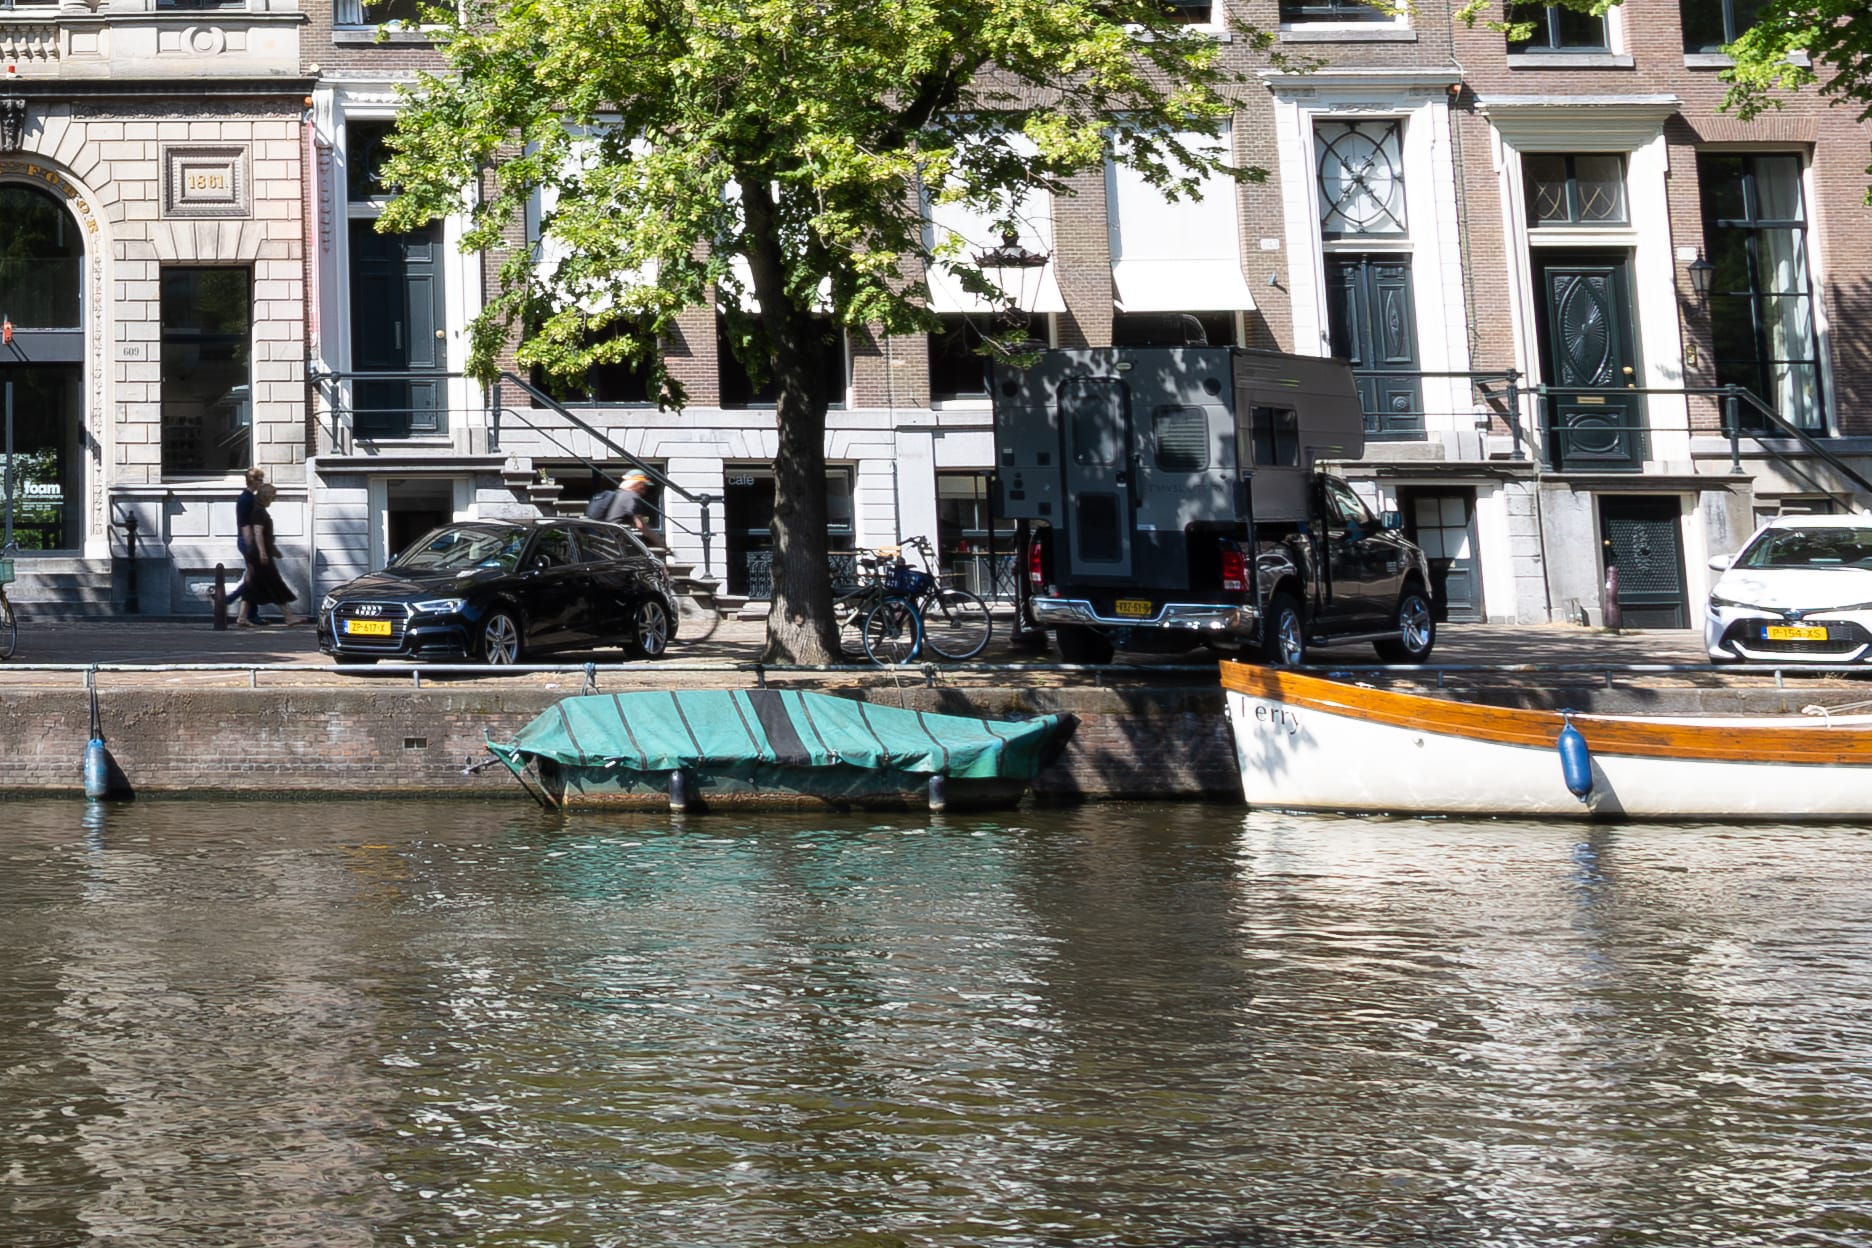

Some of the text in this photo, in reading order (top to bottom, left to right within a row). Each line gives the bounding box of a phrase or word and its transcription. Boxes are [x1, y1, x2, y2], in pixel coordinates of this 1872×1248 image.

[123, 346, 140, 357] 609
[23, 480, 61, 495] foam
[351, 622, 386, 633] ZP-617-X
[1772, 628, 1822, 639] P-154-XS
